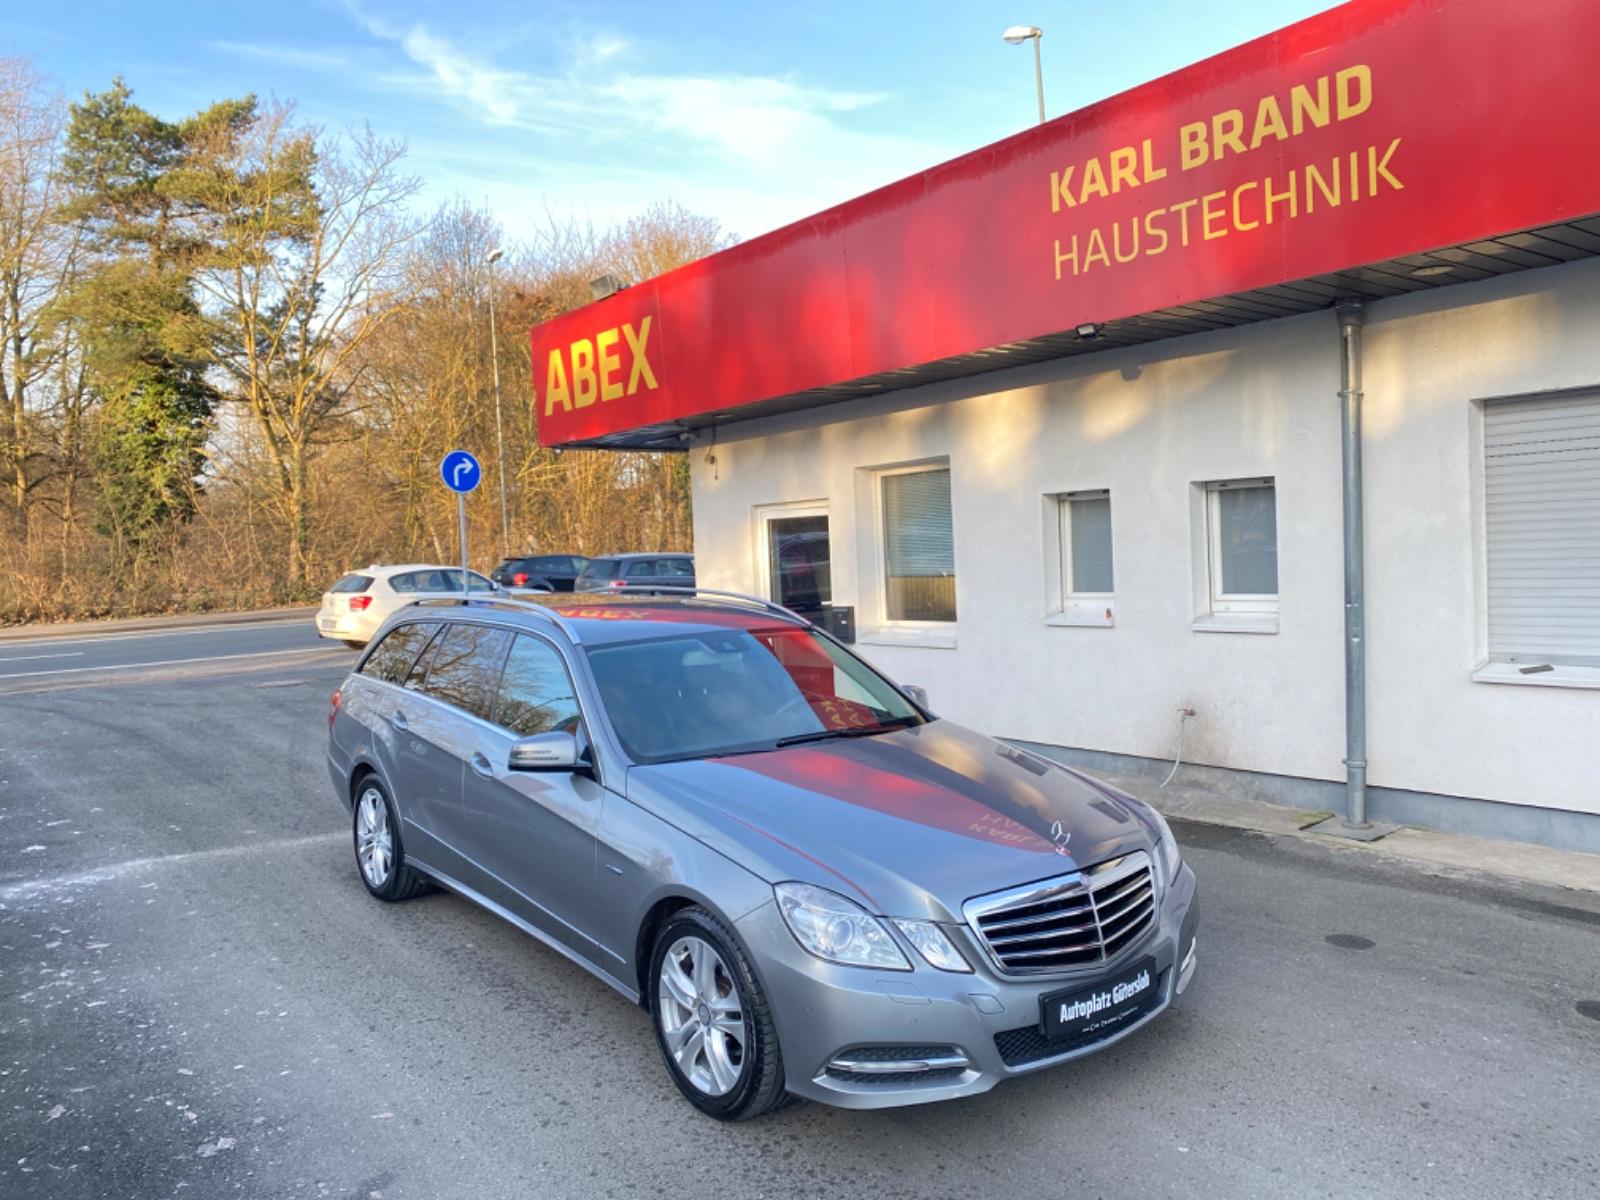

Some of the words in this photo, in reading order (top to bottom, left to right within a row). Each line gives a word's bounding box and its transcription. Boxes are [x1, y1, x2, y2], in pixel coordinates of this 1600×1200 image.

[1051, 138, 1167, 213] KARL
[1180, 64, 1373, 171] BRAND
[1053, 138, 1405, 281] HAUSTECHNIK
[544, 315, 659, 417] ABEX
[1060, 992, 1112, 1023] Autoplatz
